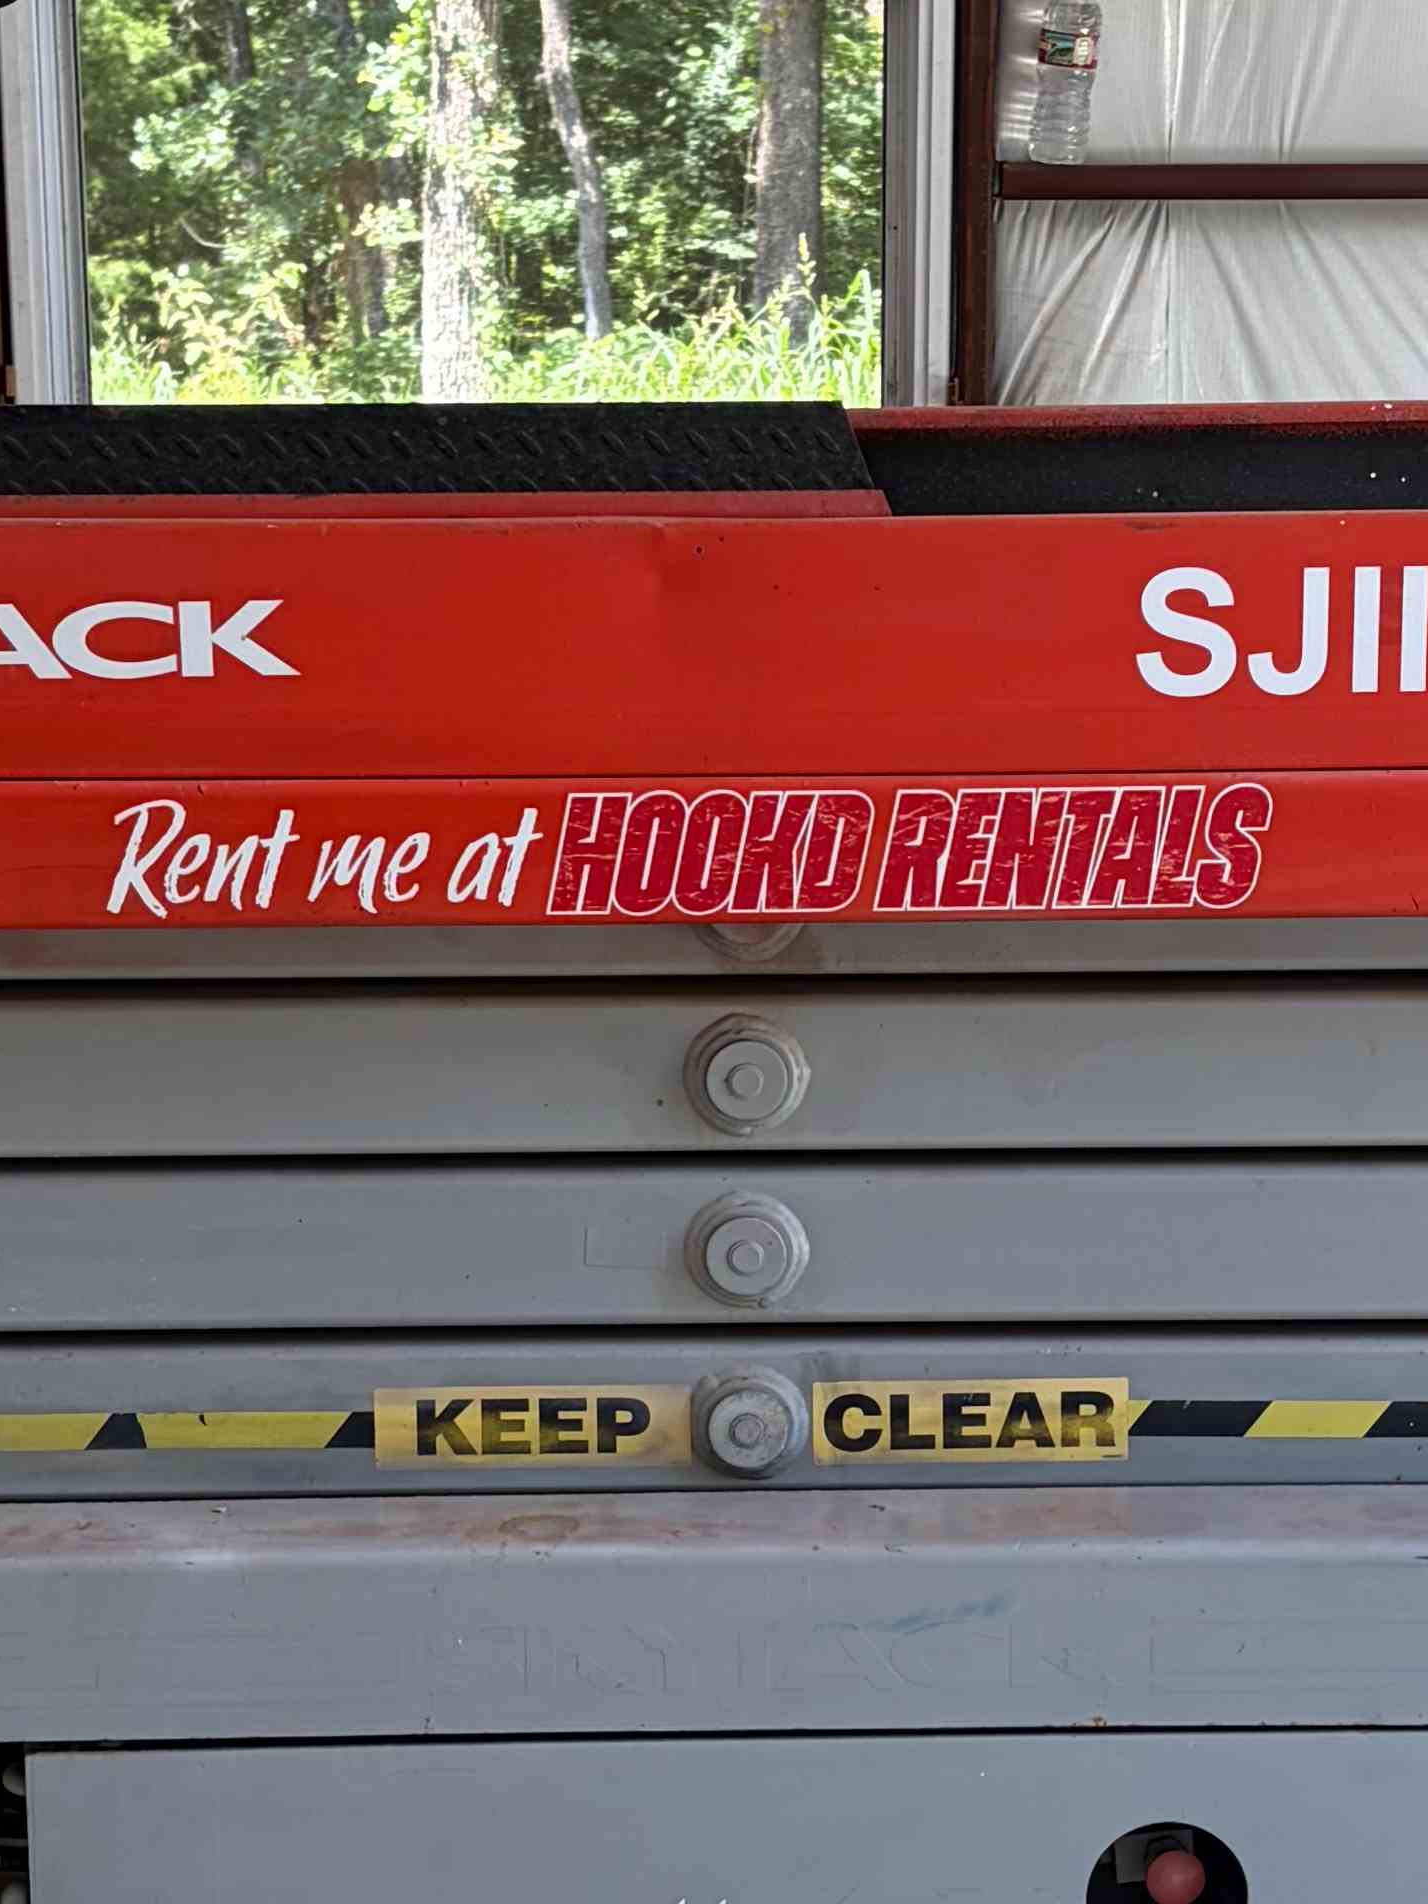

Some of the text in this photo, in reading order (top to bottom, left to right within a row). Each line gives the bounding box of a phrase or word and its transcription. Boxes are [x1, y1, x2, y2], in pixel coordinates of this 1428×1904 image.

[105, 782, 1274, 919] Rent me at HOOKD RENTALS
[415, 1390, 1114, 1457] KEEP CLEAR
